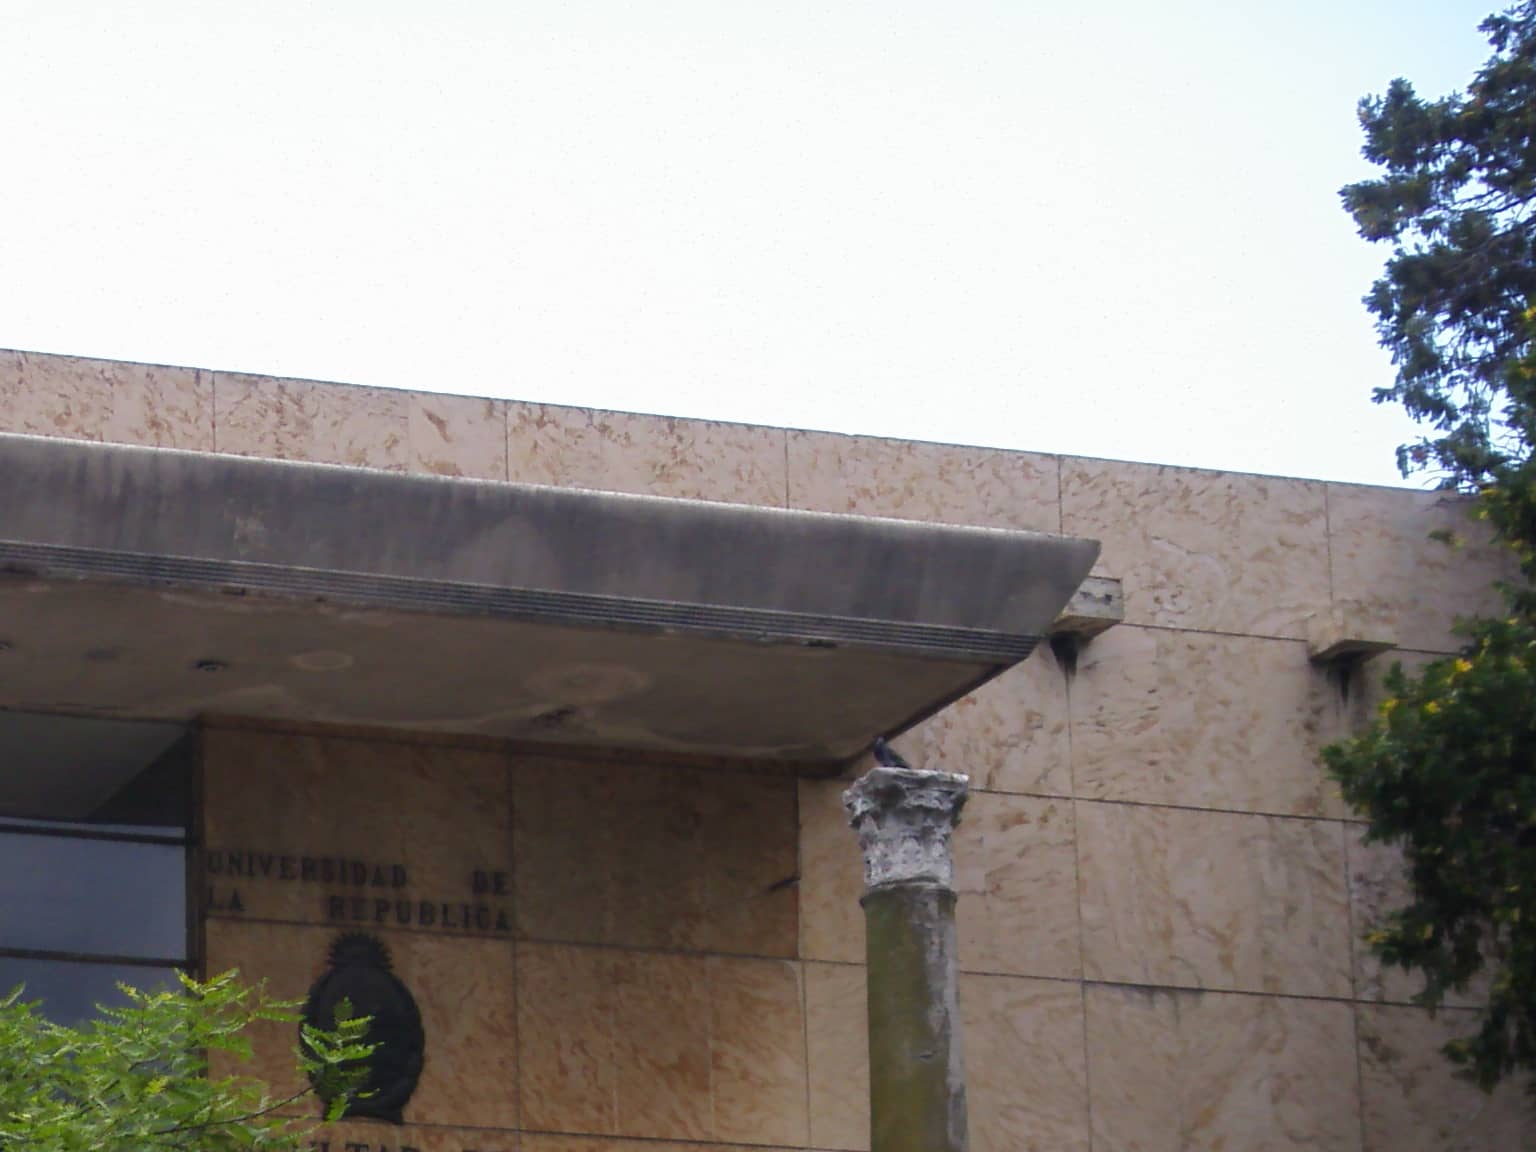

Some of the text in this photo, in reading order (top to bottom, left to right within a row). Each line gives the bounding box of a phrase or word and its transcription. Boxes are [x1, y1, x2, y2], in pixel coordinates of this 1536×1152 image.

[206, 852, 511, 896] UNIVERSIDAD DE
[206, 887, 513, 930] LA REPUBLICA
